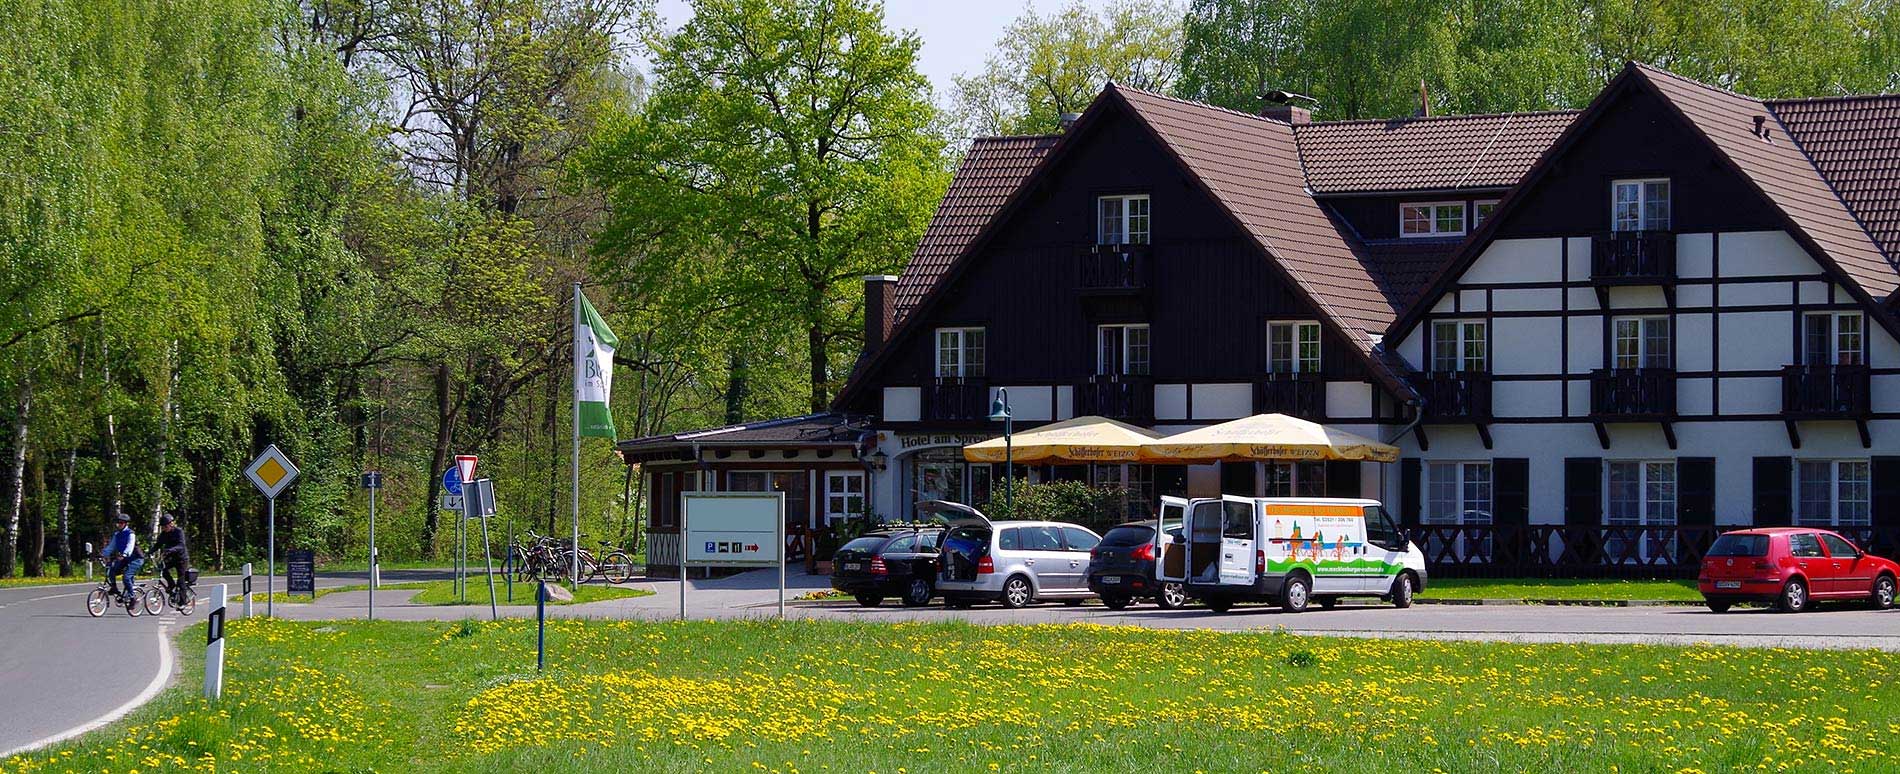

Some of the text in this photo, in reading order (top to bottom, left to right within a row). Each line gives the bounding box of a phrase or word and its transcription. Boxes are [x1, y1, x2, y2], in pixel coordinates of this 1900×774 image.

[901, 435, 930, 448] Hotel
[934, 436, 951, 444] am
[1106, 449, 1136, 457] WEIZEN
